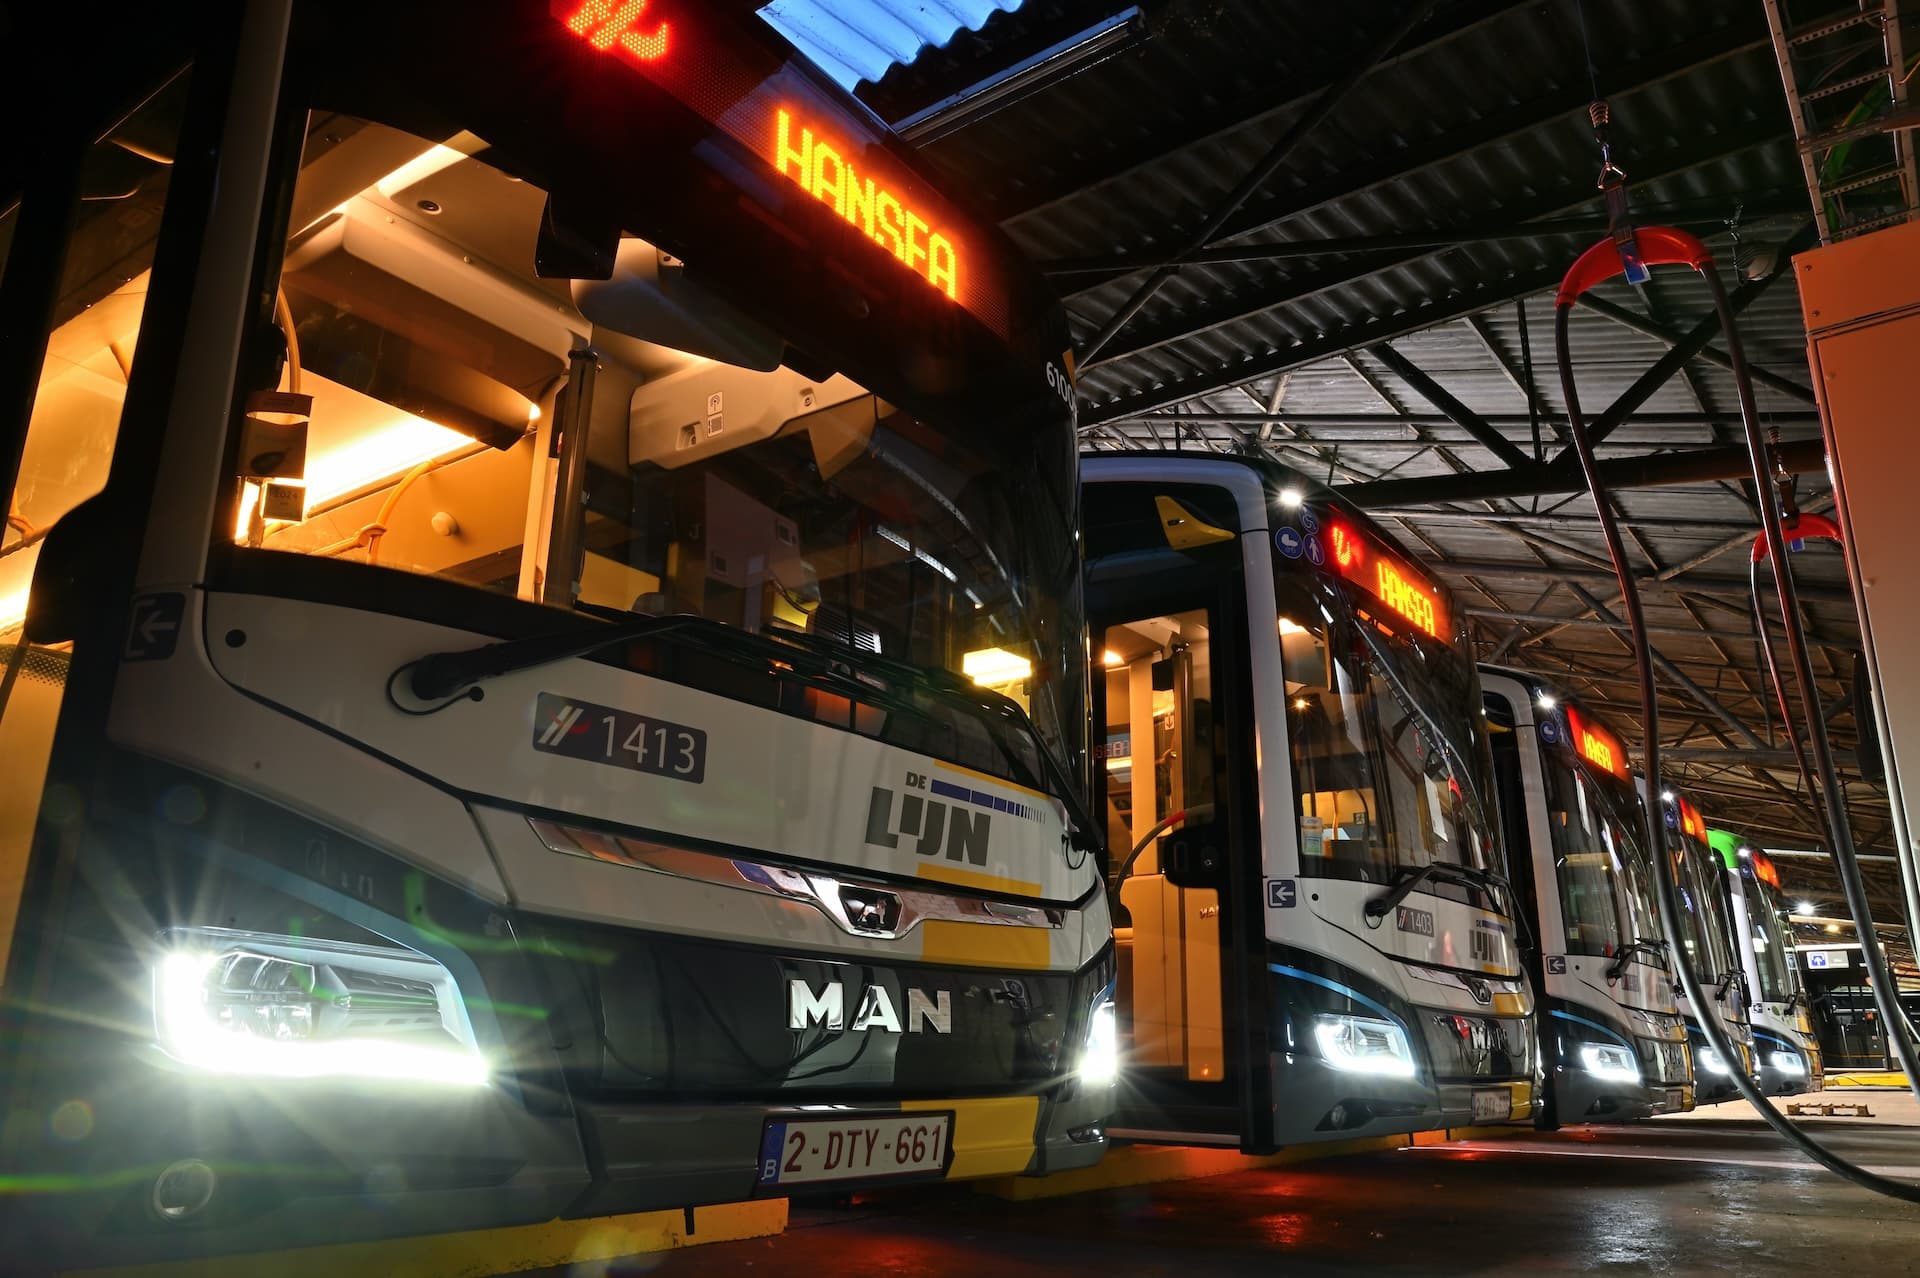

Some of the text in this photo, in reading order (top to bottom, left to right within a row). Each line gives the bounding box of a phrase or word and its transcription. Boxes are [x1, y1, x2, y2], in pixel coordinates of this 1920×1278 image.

[776, 110, 956, 299] HANSEA
[601, 715, 697, 774] 1413
[905, 771, 927, 790] DE
[864, 786, 991, 867] LIJN
[1410, 911, 1433, 934] 1403
[786, 979, 953, 1035] MAN
[763, 1123, 943, 1179] B 2-DTY-661
